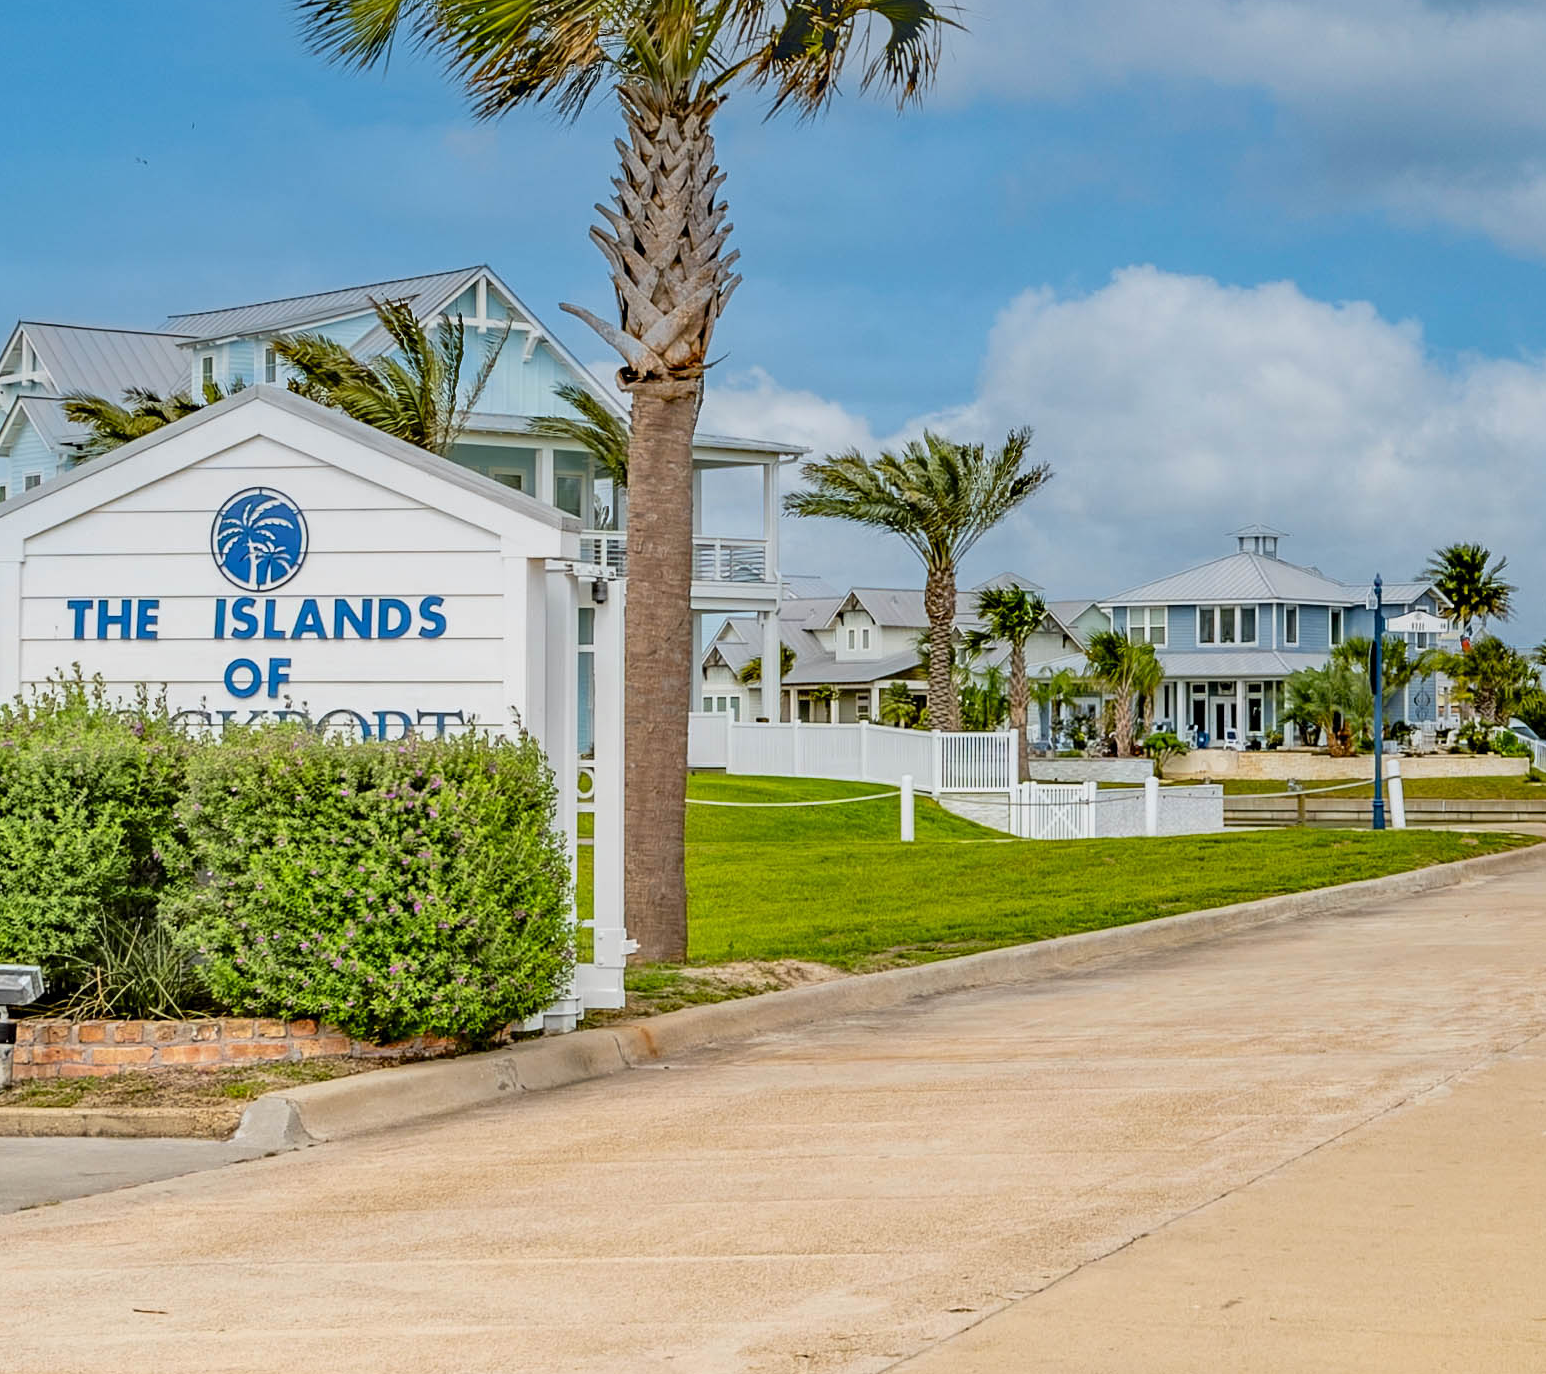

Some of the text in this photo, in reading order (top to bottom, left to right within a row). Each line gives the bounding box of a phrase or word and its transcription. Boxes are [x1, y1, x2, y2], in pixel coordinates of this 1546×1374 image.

[67, 596, 447, 641] THE ISLANDS
[224, 657, 292, 699] OF
